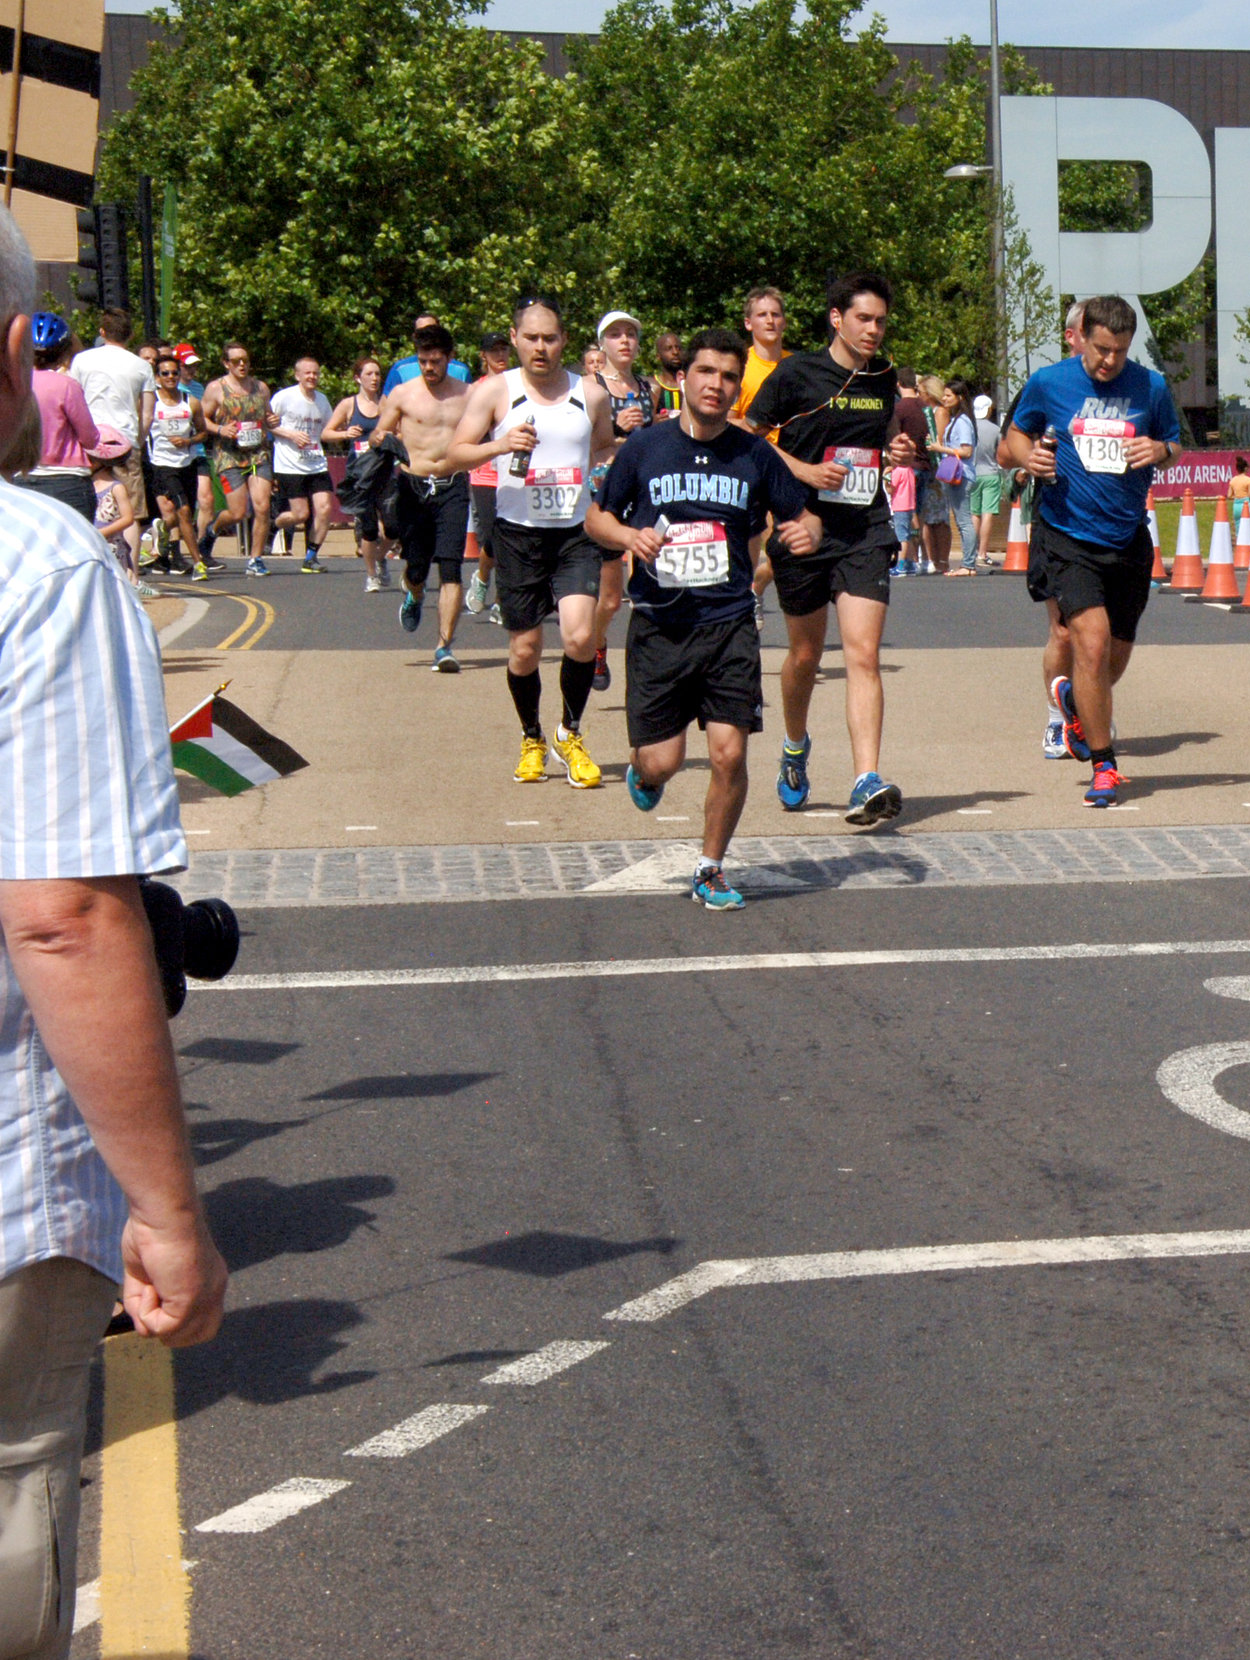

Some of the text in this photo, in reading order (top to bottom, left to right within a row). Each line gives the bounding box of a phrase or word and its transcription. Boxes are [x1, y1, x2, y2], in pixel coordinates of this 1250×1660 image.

[850, 398, 884, 410] HACKNEY
[1080, 397, 1131, 420] RUN
[168, 420, 179, 432] 53
[845, 468, 877, 494] 010
[1152, 465, 1233, 485] ER BOX ARENA
[531, 486, 576, 510] 3302
[649, 473, 749, 511] COLUMBIA
[663, 544, 719, 576] 5755
